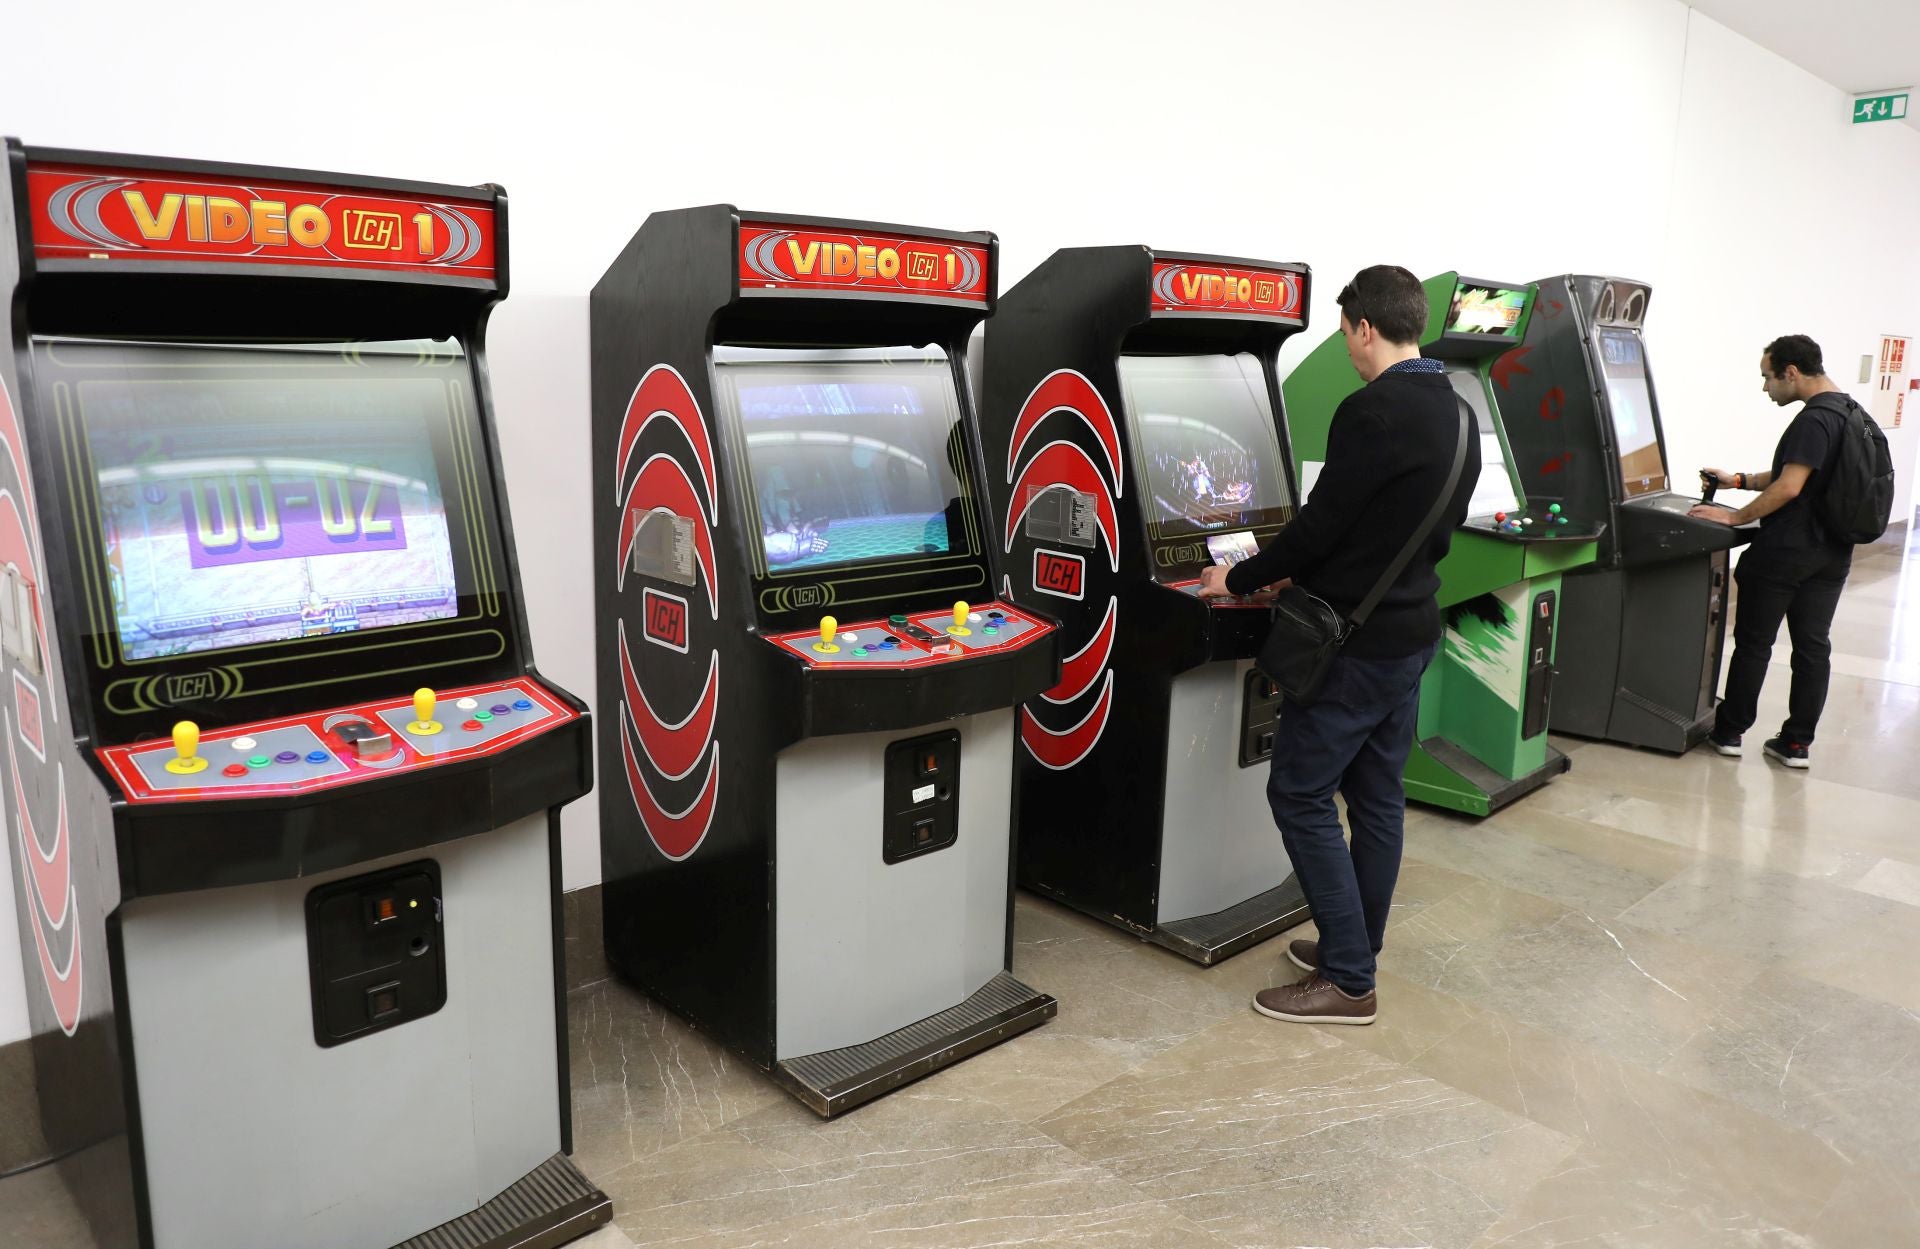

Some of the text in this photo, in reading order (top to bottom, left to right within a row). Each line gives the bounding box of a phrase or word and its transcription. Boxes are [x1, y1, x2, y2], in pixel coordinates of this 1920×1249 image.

[121, 190, 434, 255] VIDEO TCH 1
[786, 239, 956, 284] VIDEO TCH 1
[1180, 272, 1285, 306] VIDEO TCH 1
[191, 463, 394, 548] 00-02
[794, 587, 818, 605] TCH
[169, 672, 212, 700] TCH
